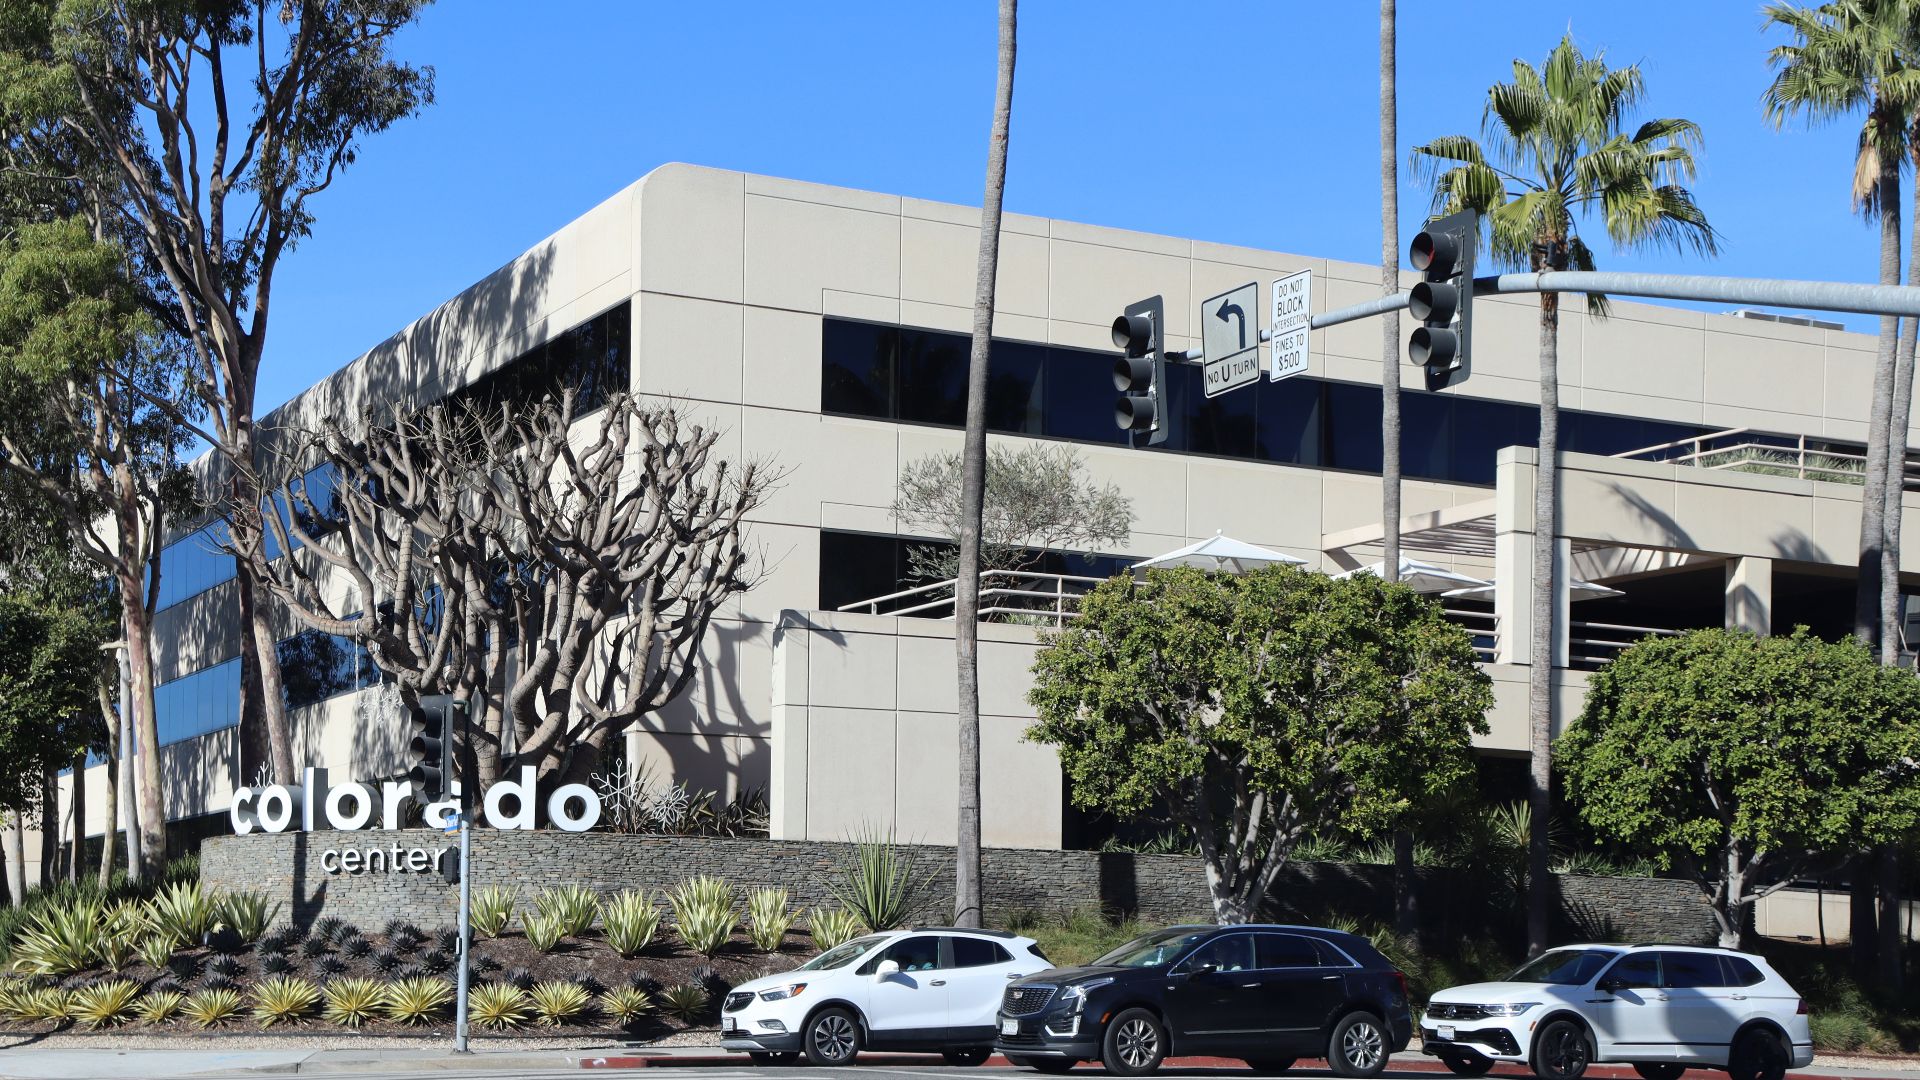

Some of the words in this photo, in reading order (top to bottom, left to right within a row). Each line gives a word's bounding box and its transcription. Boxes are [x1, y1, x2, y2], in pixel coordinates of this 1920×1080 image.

[1278, 284, 1288, 298] DO
[1290, 278, 1304, 293] NOT
[1277, 294, 1304, 317] BLOCK
[1271, 313, 1309, 332] INTERSECTION
[1275, 339, 1294, 353] FINES
[1296, 333, 1304, 347] TO
[1207, 371, 1219, 385] NO
[1221, 363, 1230, 382] U
[1232, 357, 1256, 376] TURN
[1278, 350, 1300, 371] $500
[321, 842, 449, 872] center
